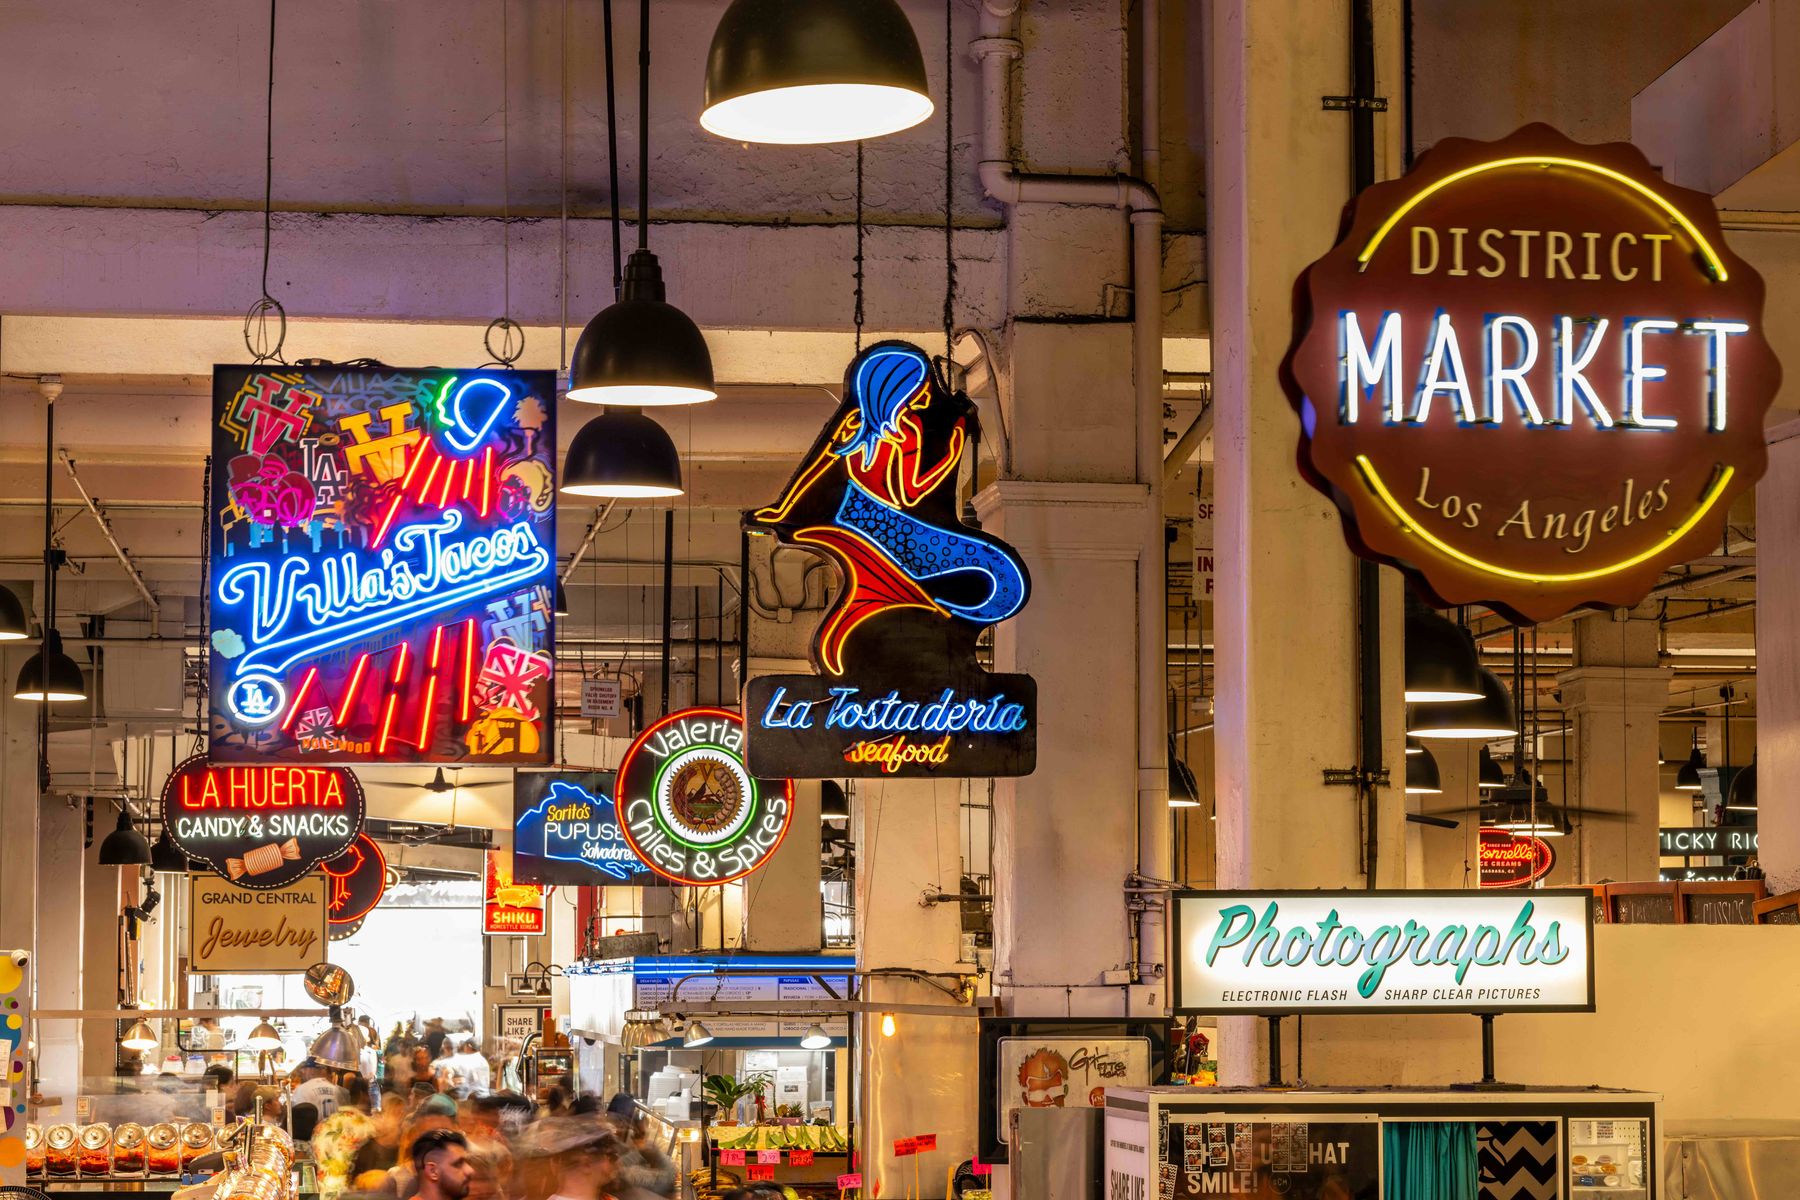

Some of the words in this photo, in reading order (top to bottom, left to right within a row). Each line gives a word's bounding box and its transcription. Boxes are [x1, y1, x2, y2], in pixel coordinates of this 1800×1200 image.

[1410, 226, 1673, 282] DISTRICT
[1340, 309, 1750, 432] MARKET
[1415, 467, 1482, 529] Los
[1496, 478, 1671, 554] Angeles
[218, 548, 416, 644] Villa's
[395, 509, 539, 594] Tacos
[240, 683, 274, 714] LA
[760, 686, 814, 729] La
[825, 687, 1028, 733] Tostadería
[302, 738, 371, 754] HOLLYWOOD
[644, 719, 743, 757] Valeria
[845, 735, 951, 773] seafood
[183, 771, 220, 808] LA
[231, 767, 343, 807] HUERTA
[178, 817, 244, 839] CANDY
[248, 814, 263, 838] &
[268, 813, 349, 836] SNACKS
[628, 799, 686, 873] Chiles
[692, 851, 718, 878] &
[719, 798, 787, 877] Spices
[1659, 832, 1717, 849] ICKY
[1732, 832, 1759, 849] RI
[202, 893, 251, 904] GRAND
[256, 893, 316, 904] CENTRAL
[493, 911, 535, 924] SHIKU
[201, 915, 318, 960] Jewelry
[1206, 899, 1570, 999] Photographs
[1222, 990, 1302, 1001] ELECTRONIC
[1306, 989, 1348, 1001] FLASH
[1384, 988, 1428, 1000] SHARP
[1432, 988, 1473, 1000] CLEAR
[1477, 988, 1541, 999] PICTURES
[507, 1017, 533, 1025] SHARE
[508, 1027, 524, 1036] LIKE
[1309, 1142, 1350, 1164] HAT
[1187, 1172, 1258, 1194] SMILE!
